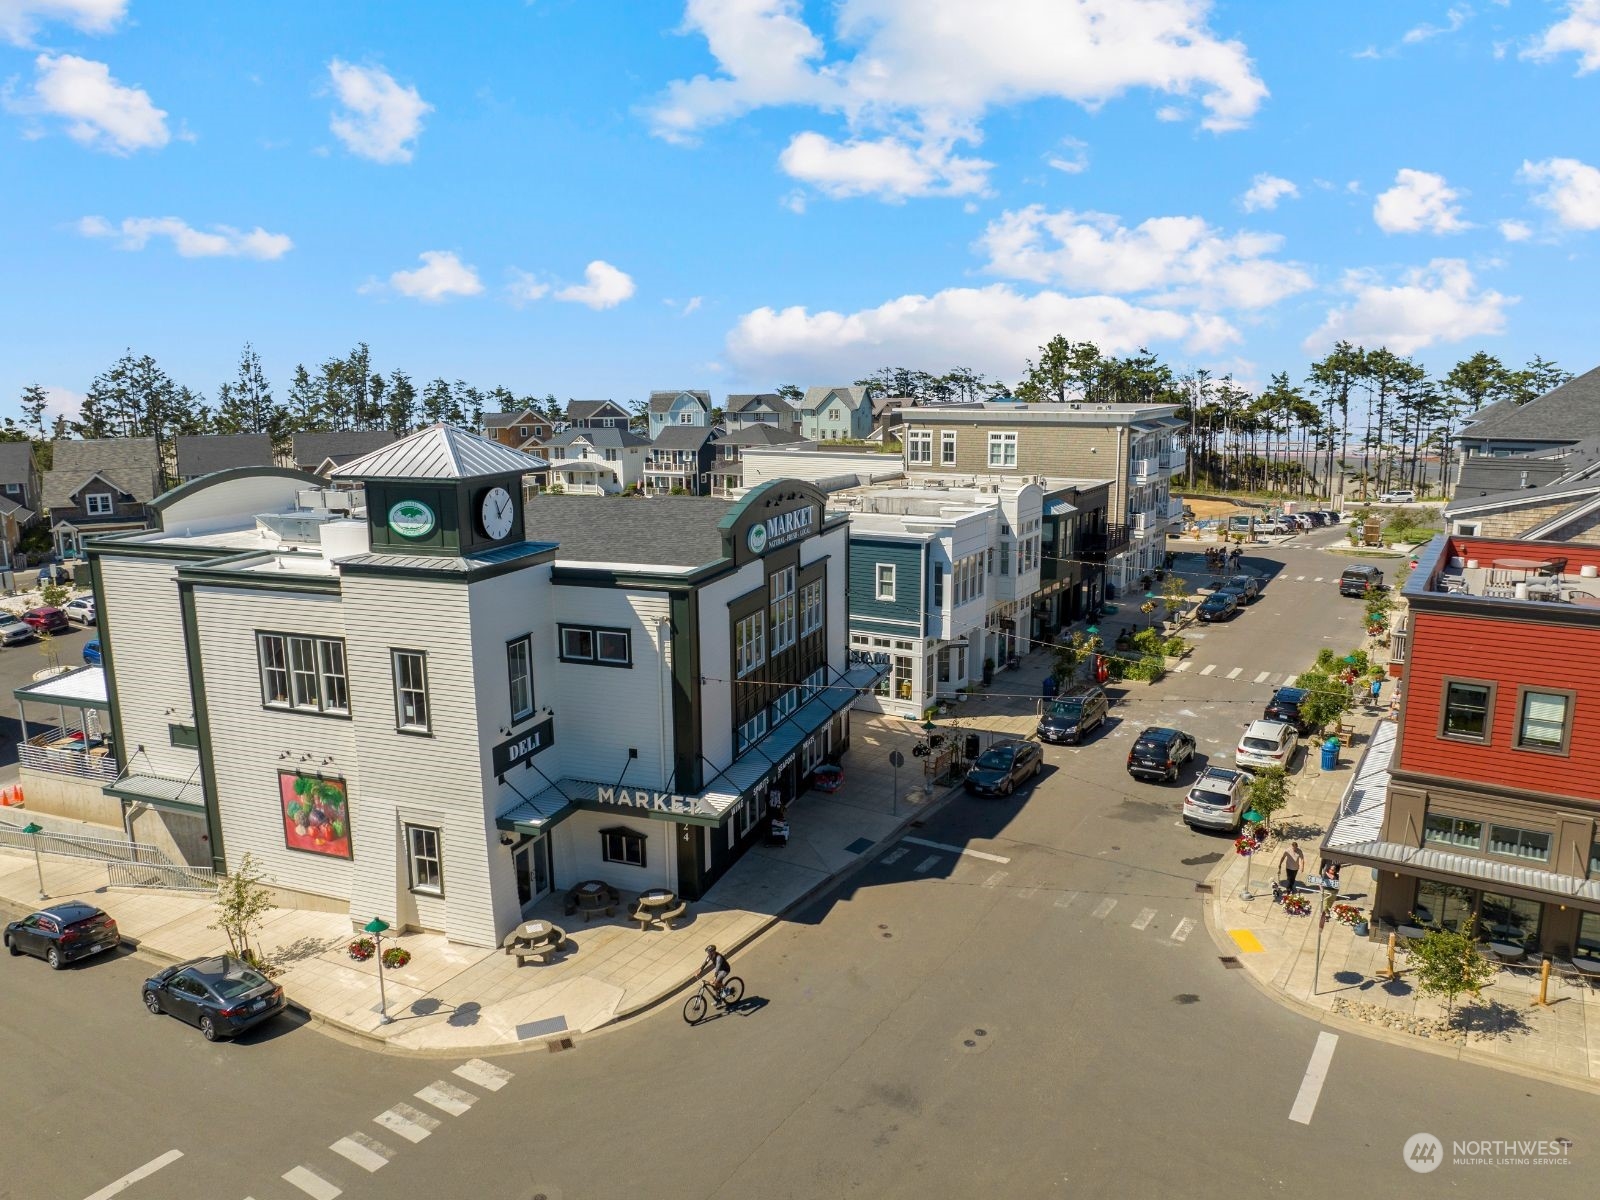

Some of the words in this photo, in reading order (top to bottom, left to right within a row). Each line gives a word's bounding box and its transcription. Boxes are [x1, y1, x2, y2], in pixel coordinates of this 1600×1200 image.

[766, 505, 814, 540] MARKET
[509, 731, 541, 762] DELI
[598, 787, 701, 815] MARKET
[730, 799, 744, 816] WINE
